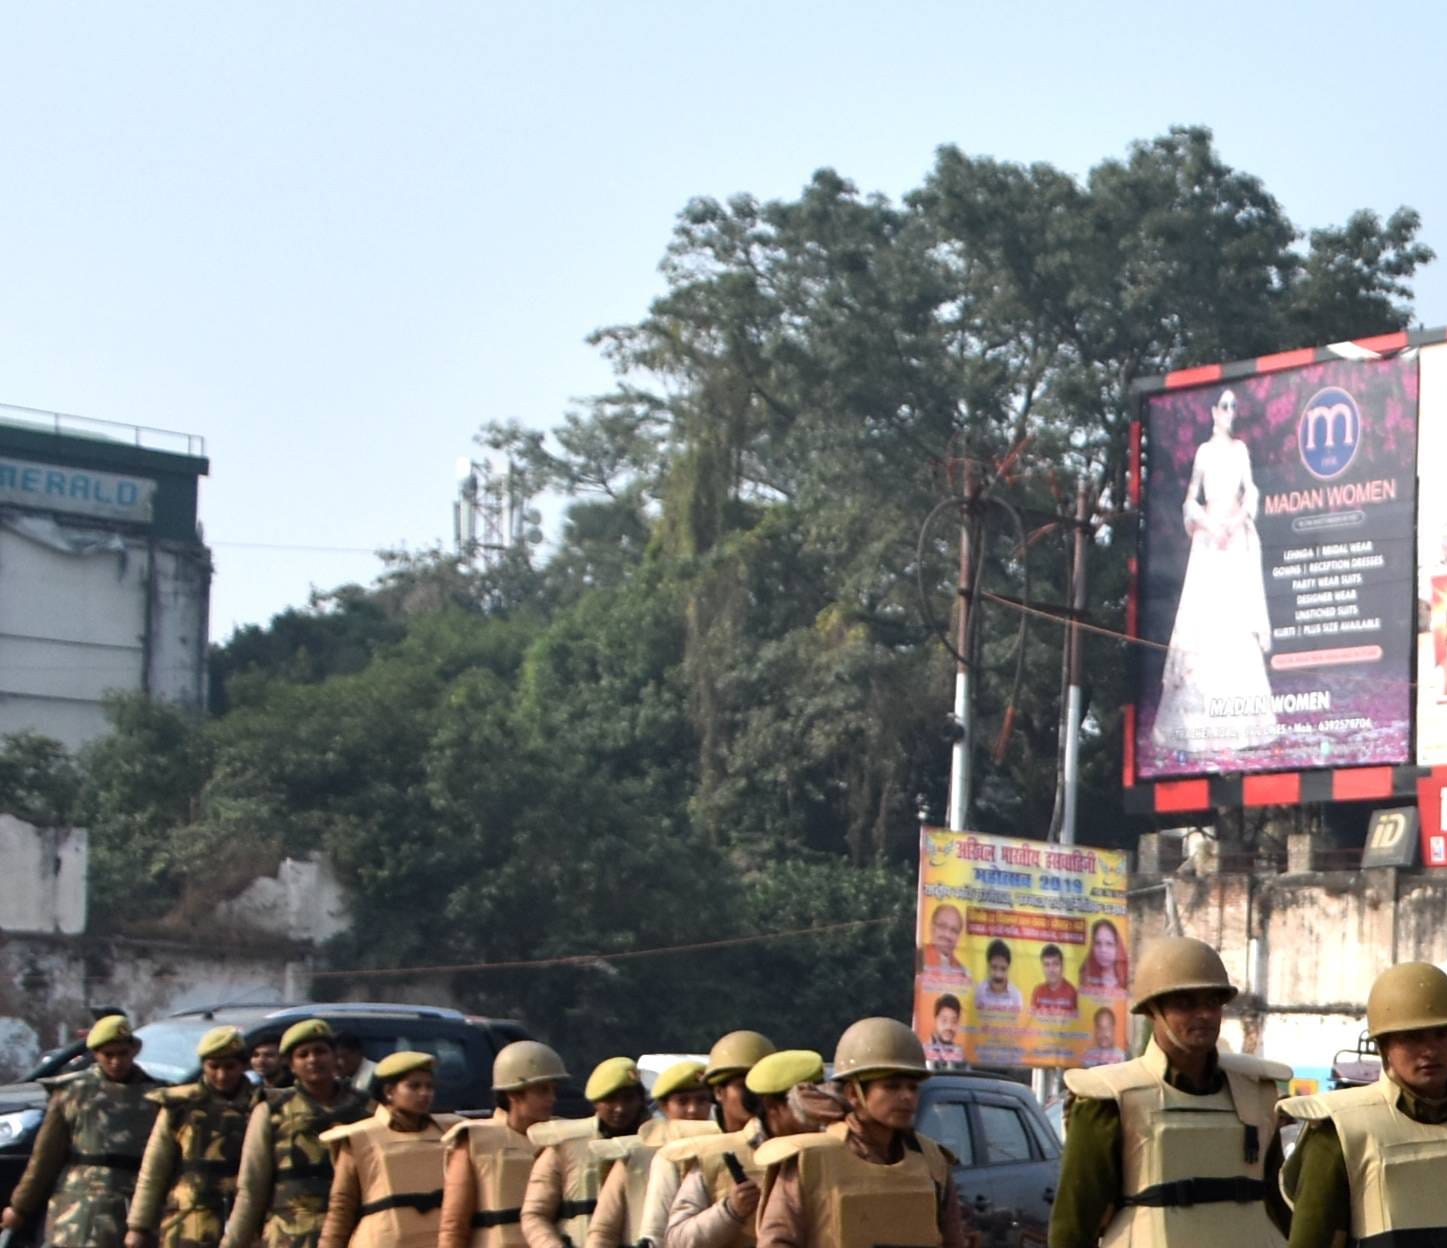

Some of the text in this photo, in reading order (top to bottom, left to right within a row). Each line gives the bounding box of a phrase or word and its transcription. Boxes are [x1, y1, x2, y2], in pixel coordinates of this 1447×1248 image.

[1265, 479, 1396, 515] MADAN WOMEN
[1271, 691, 1331, 713] WOMEN
